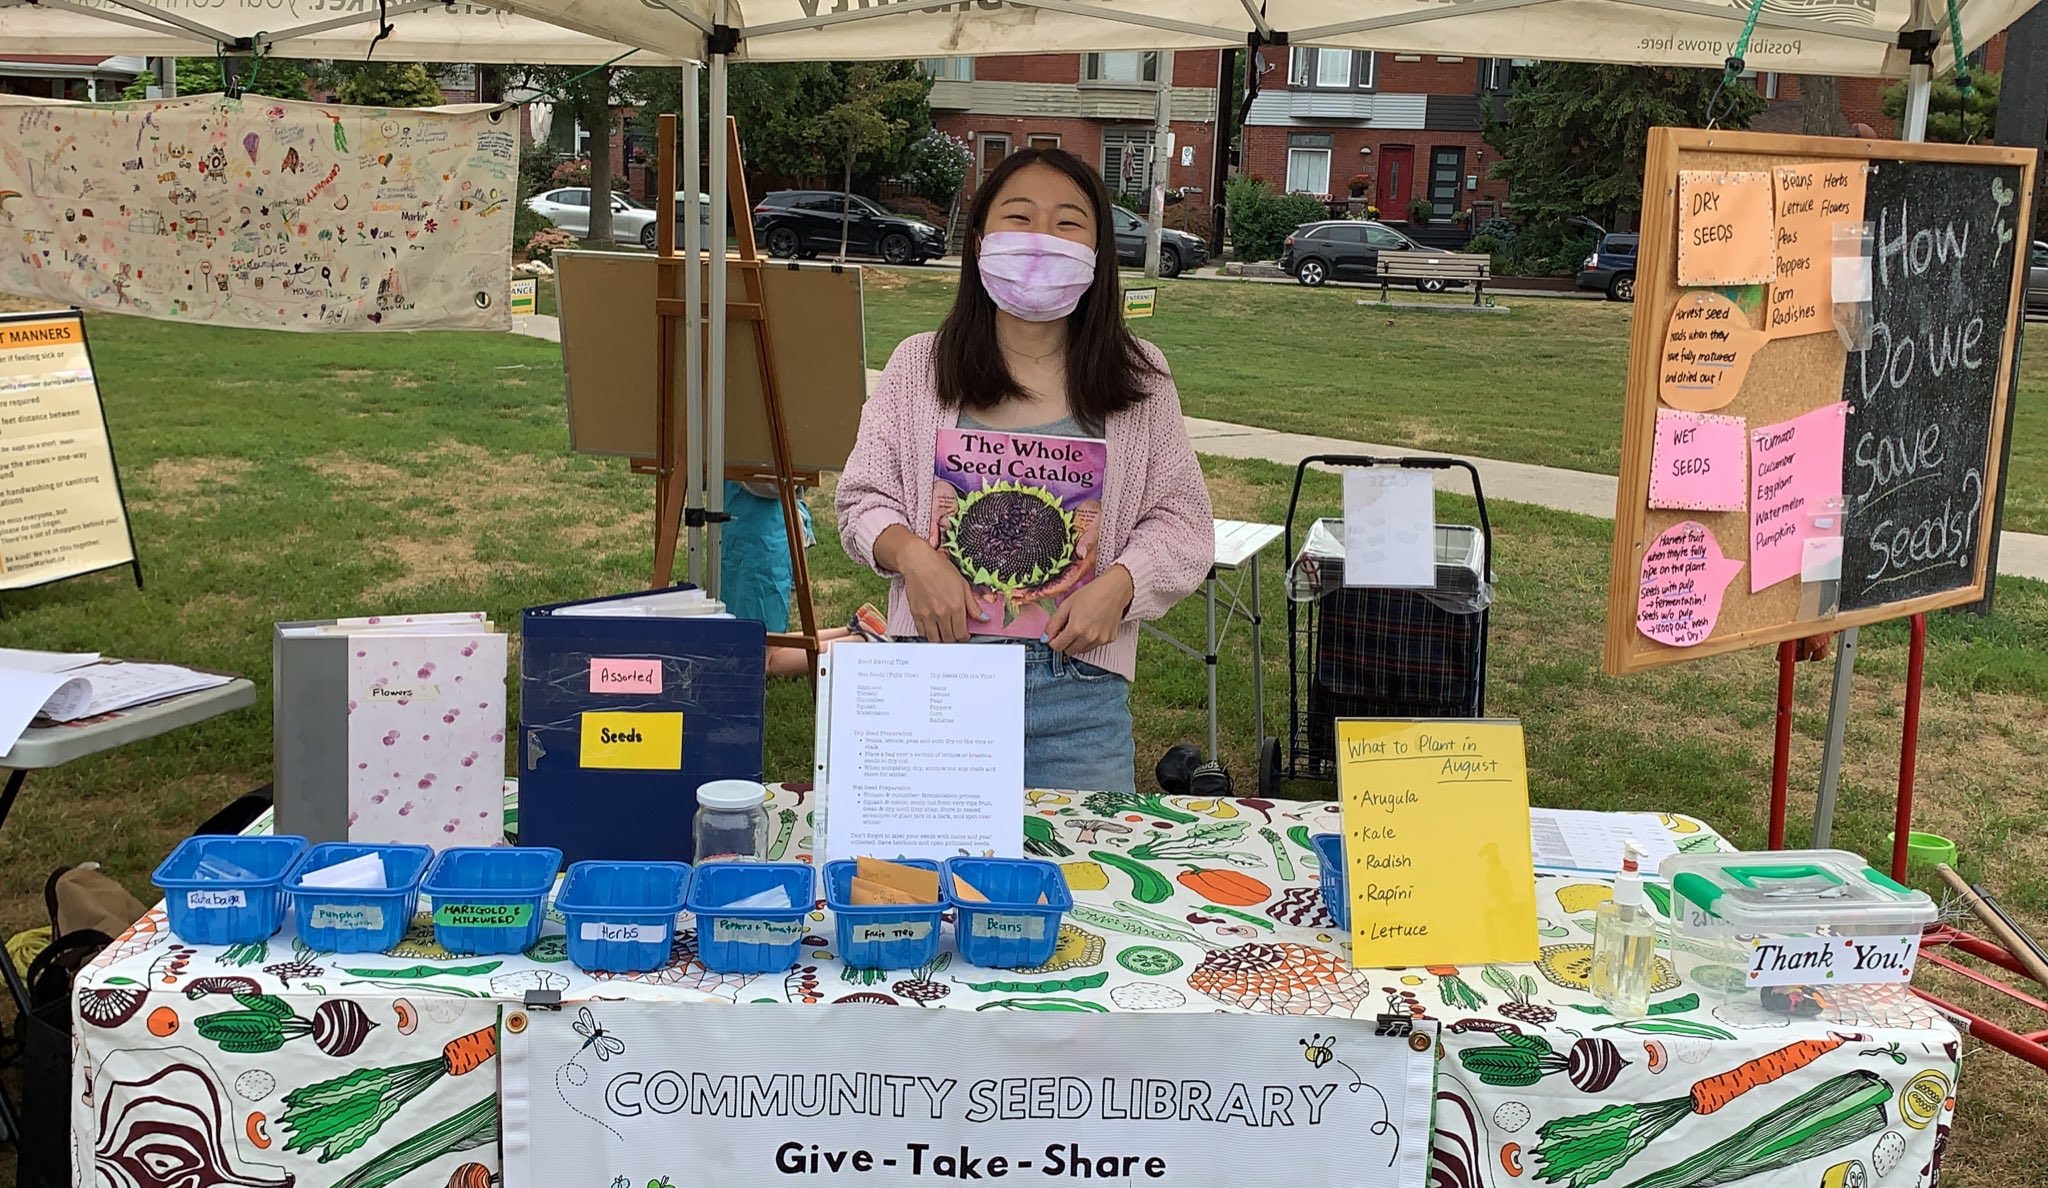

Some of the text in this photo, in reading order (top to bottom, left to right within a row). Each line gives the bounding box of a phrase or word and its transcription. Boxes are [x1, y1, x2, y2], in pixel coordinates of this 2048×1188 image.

[1782, 174, 1848, 191] Beans Herbs
[1693, 192, 1720, 216] DRY
[1781, 199, 1850, 218] Lettuce Flowers
[401, 211, 428, 222] Market
[1693, 224, 1733, 246] SEEDS
[1777, 228, 1798, 250] Peas
[1879, 197, 1970, 290] How
[257, 243, 288, 258] LOVE
[1776, 256, 1811, 277] Peppers
[1772, 286, 1794, 305] Corn
[1705, 307, 1731, 320] seed
[1771, 305, 1816, 328] Radishes
[10, 327, 71, 342] MANNERS
[1689, 330, 1708, 342] when
[1710, 330, 1730, 343] they
[14, 353, 40, 361] feeling
[1681, 348, 1697, 365] fully
[1697, 352, 1737, 363] matured
[1860, 321, 1915, 409] Do
[1665, 371, 1678, 383] and
[1677, 371, 1697, 383] dried
[9, 396, 40, 407] required
[2, 409, 80, 425] feet distance between
[1673, 428, 1697, 446] WET
[1756, 427, 1796, 452] Tomato
[960, 434, 1084, 463] The Whole
[11, 460, 23, 469] the
[25, 457, 50, 466] arrows
[57, 452, 87, 462] one-way
[1672, 458, 1711, 477] SEEDS
[1758, 453, 1796, 478] Cucumber
[945, 454, 1094, 488] Seed Catalog
[6, 482, 55, 496] handwashing
[65, 476, 100, 488] sanitizing
[1757, 475, 1793, 500] Eggplant
[0, 497, 23, 507] ations
[56, 508, 68, 516] but
[1755, 496, 1805, 526] Watermelon
[45, 529, 51, 537] of
[52, 525, 82, 535] shoppers
[83, 519, 105, 529] behind
[1659, 531, 1705, 547] Harvest fruit
[1756, 523, 1796, 551] Pumpkins
[1647, 551, 1666, 563] when
[1690, 546, 1707, 558] fully
[1642, 565, 1658, 579] ripe
[1660, 566, 1671, 575] on
[1671, 561, 1685, 573] the
[1640, 578, 1695, 600] Seeds with pulp
[1661, 610, 1675, 620] w/o
[1678, 609, 1694, 621] pulp
[1692, 619, 1709, 631] wash
[600, 668, 654, 685] Assorted
[372, 688, 413, 697] Flowers
[600, 728, 643, 743] Seeds
[1348, 734, 1476, 759] What to Plant in
[1441, 758, 1498, 780] August
[1360, 790, 1418, 813] Arugula
[1362, 826, 1396, 842] Kale
[1366, 854, 1412, 870] Radish
[1367, 884, 1414, 907] Rapini
[319, 909, 364, 922] Pumpkin
[444, 905, 506, 915] MARIGOLD
[452, 915, 515, 925] MILKWEED
[987, 917, 1022, 933] Beans
[601, 925, 639, 939] Herbs
[864, 929, 885, 939] Fruit
[1370, 922, 1429, 940] Lettuce
[1753, 942, 1912, 971] Thank You!
[605, 1070, 1338, 1128] COMMUNITY SEED LIBRARY
